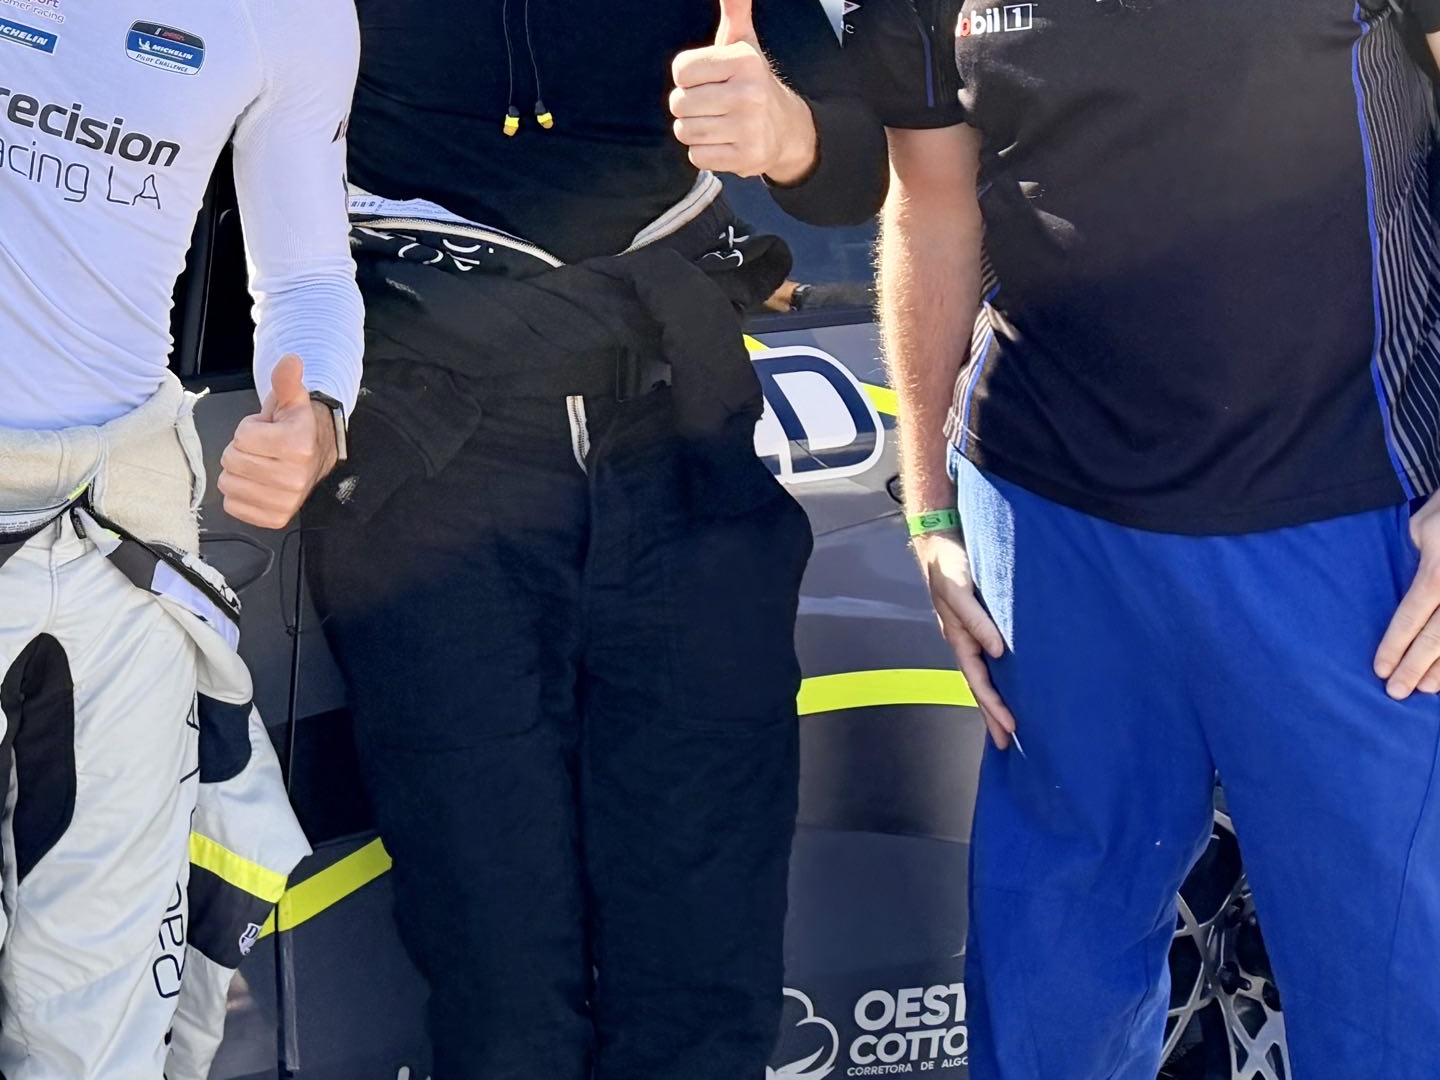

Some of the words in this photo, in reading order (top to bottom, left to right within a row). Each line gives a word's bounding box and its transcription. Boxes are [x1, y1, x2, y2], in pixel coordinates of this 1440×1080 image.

[33, 6, 65, 24] racing
[955, 7, 1000, 36] obil
[152, 45, 194, 60] MICHELIN
[107, 164, 161, 210] LA
[847, 1063, 913, 1077] CORRETORA
[920, 1060, 935, 1071] DE
